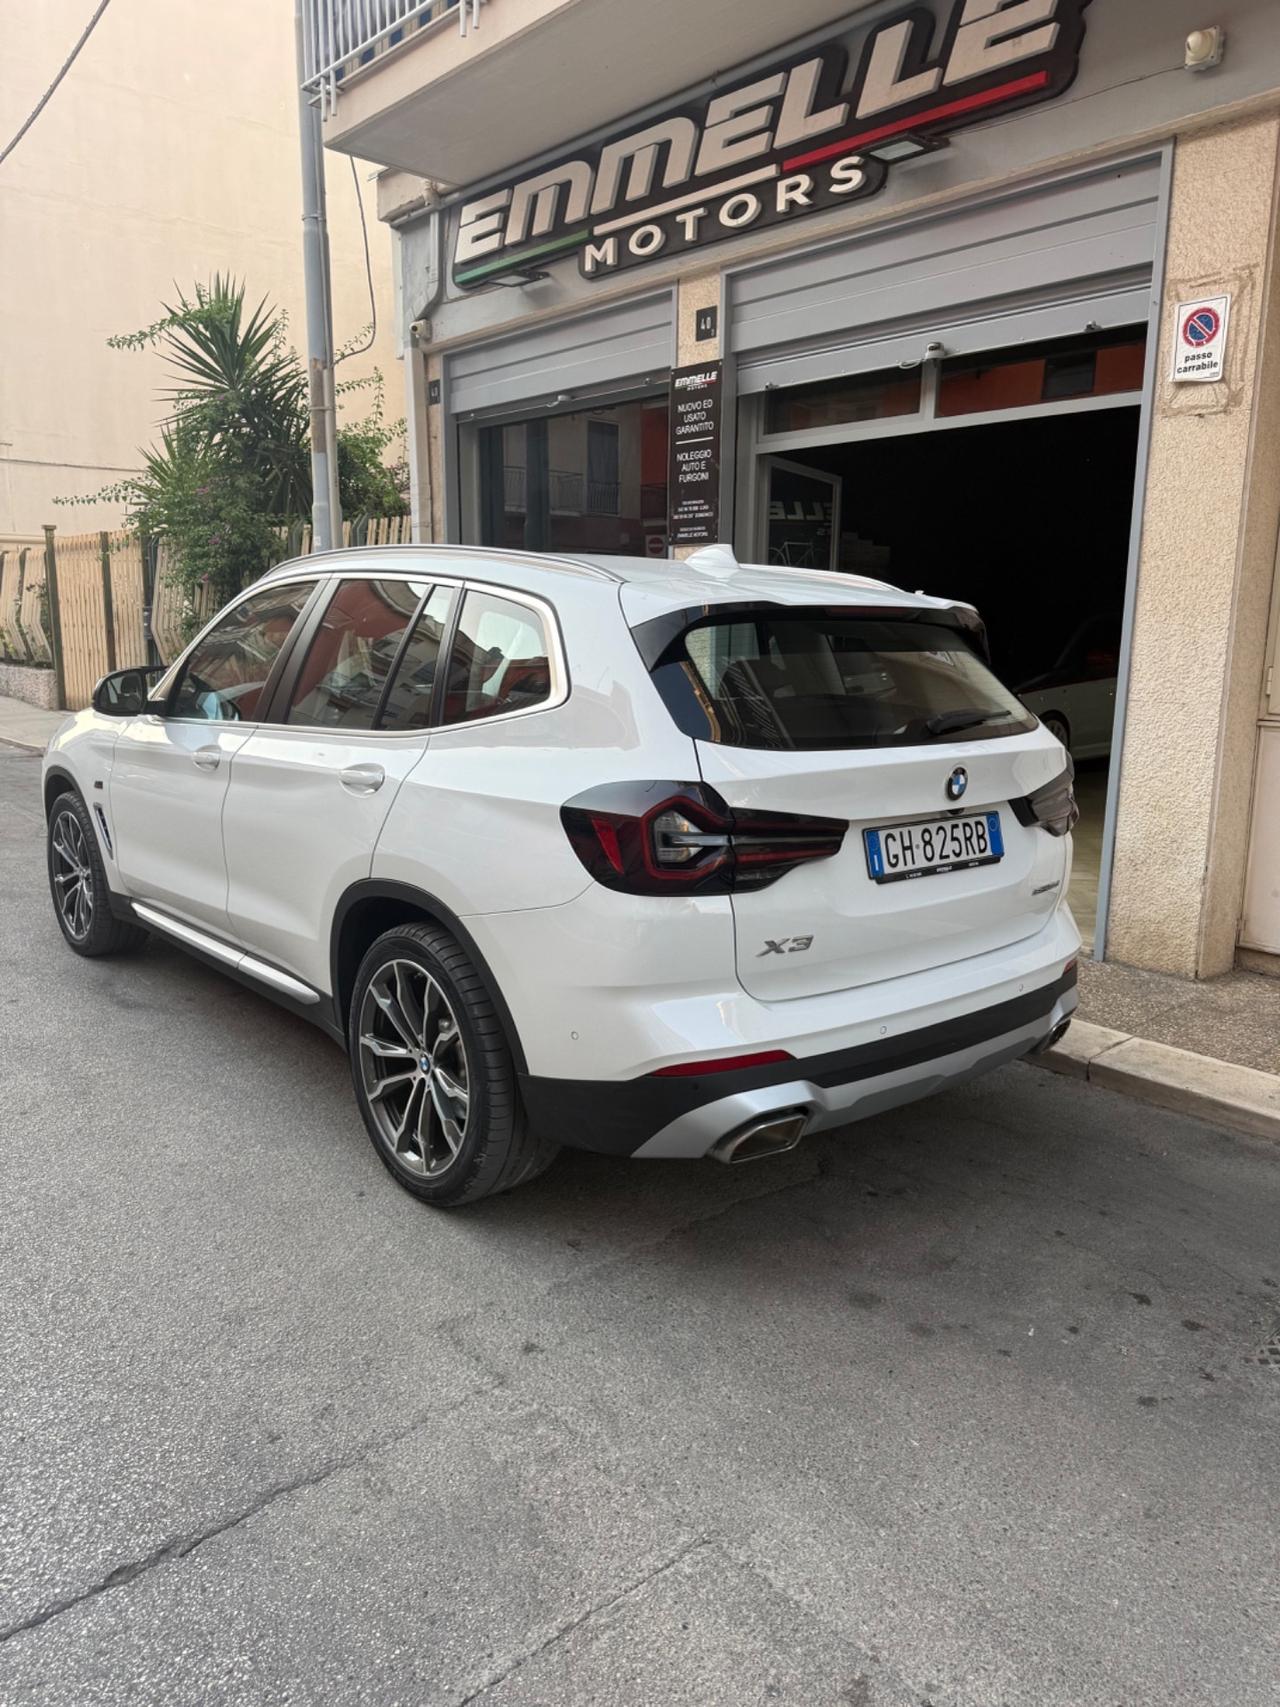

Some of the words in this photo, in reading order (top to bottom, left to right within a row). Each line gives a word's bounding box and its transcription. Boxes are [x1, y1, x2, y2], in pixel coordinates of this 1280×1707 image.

[454, 0, 1060, 264] EMMELLE
[584, 155, 867, 273] MOTORS
[1184, 351, 1213, 363] passo
[1176, 361, 1219, 374] carrabile
[674, 371, 718, 388] EMMELLE
[677, 401, 702, 413] NUOVO
[702, 399, 713, 409] ED
[683, 411, 706, 423] USATO
[675, 421, 715, 435] GARANTITO
[676, 449, 712, 462] NOLEGGIO
[681, 461, 700, 472] AUTO
[700, 460, 706, 470] E
[678, 471, 710, 483] FURGONI
[754, 933, 814, 958] X3
